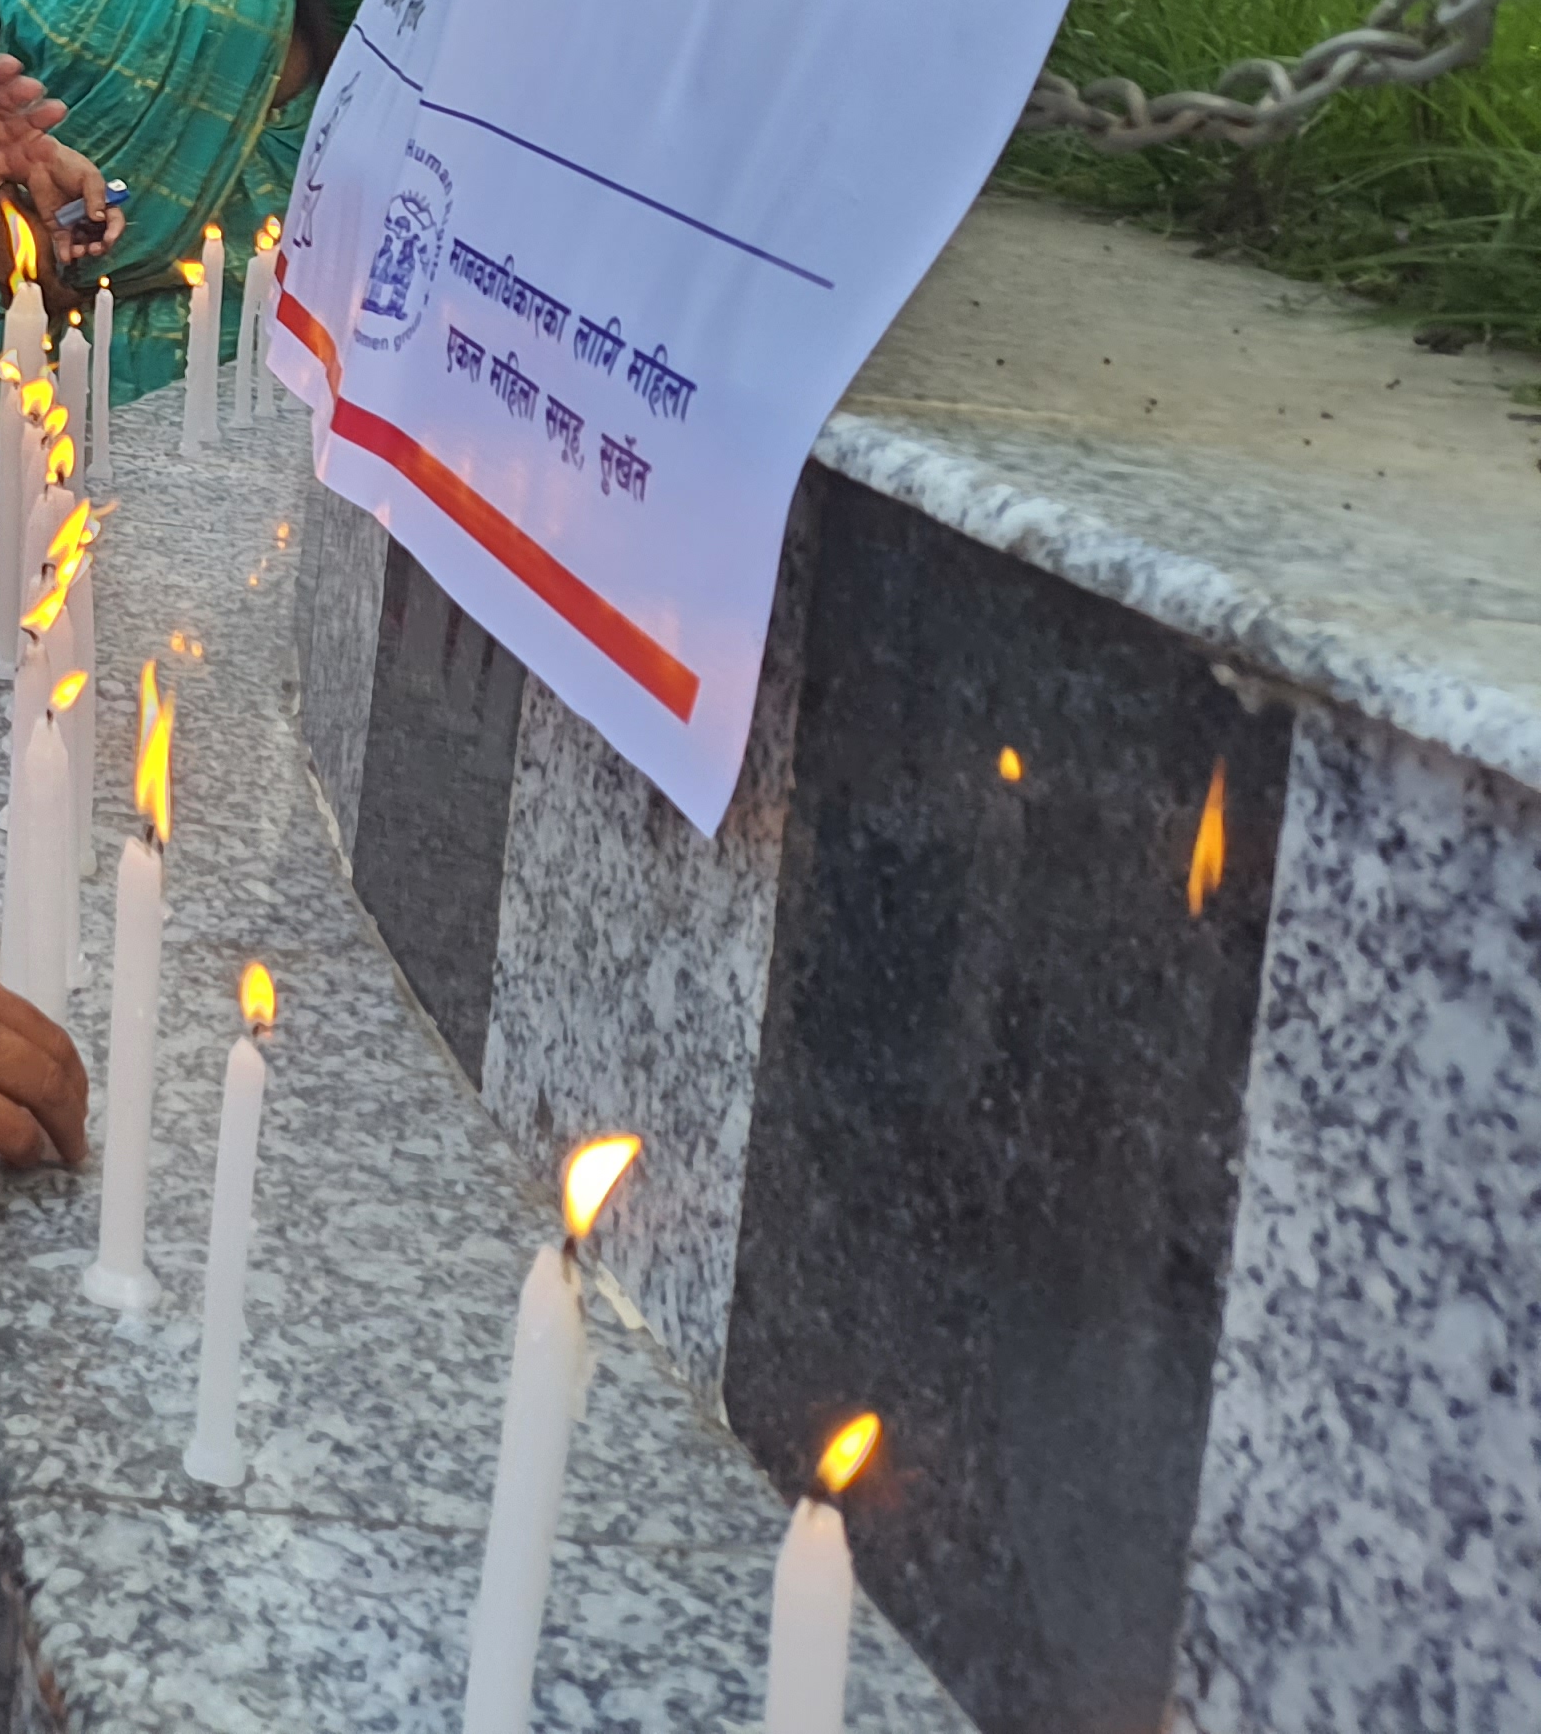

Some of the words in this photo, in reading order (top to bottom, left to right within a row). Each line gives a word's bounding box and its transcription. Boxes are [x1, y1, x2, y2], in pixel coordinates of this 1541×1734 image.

[447, 324, 486, 384] एकल
[490, 351, 540, 422] महिला
[574, 316, 626, 377] लागि
[628, 344, 698, 423] महिला
